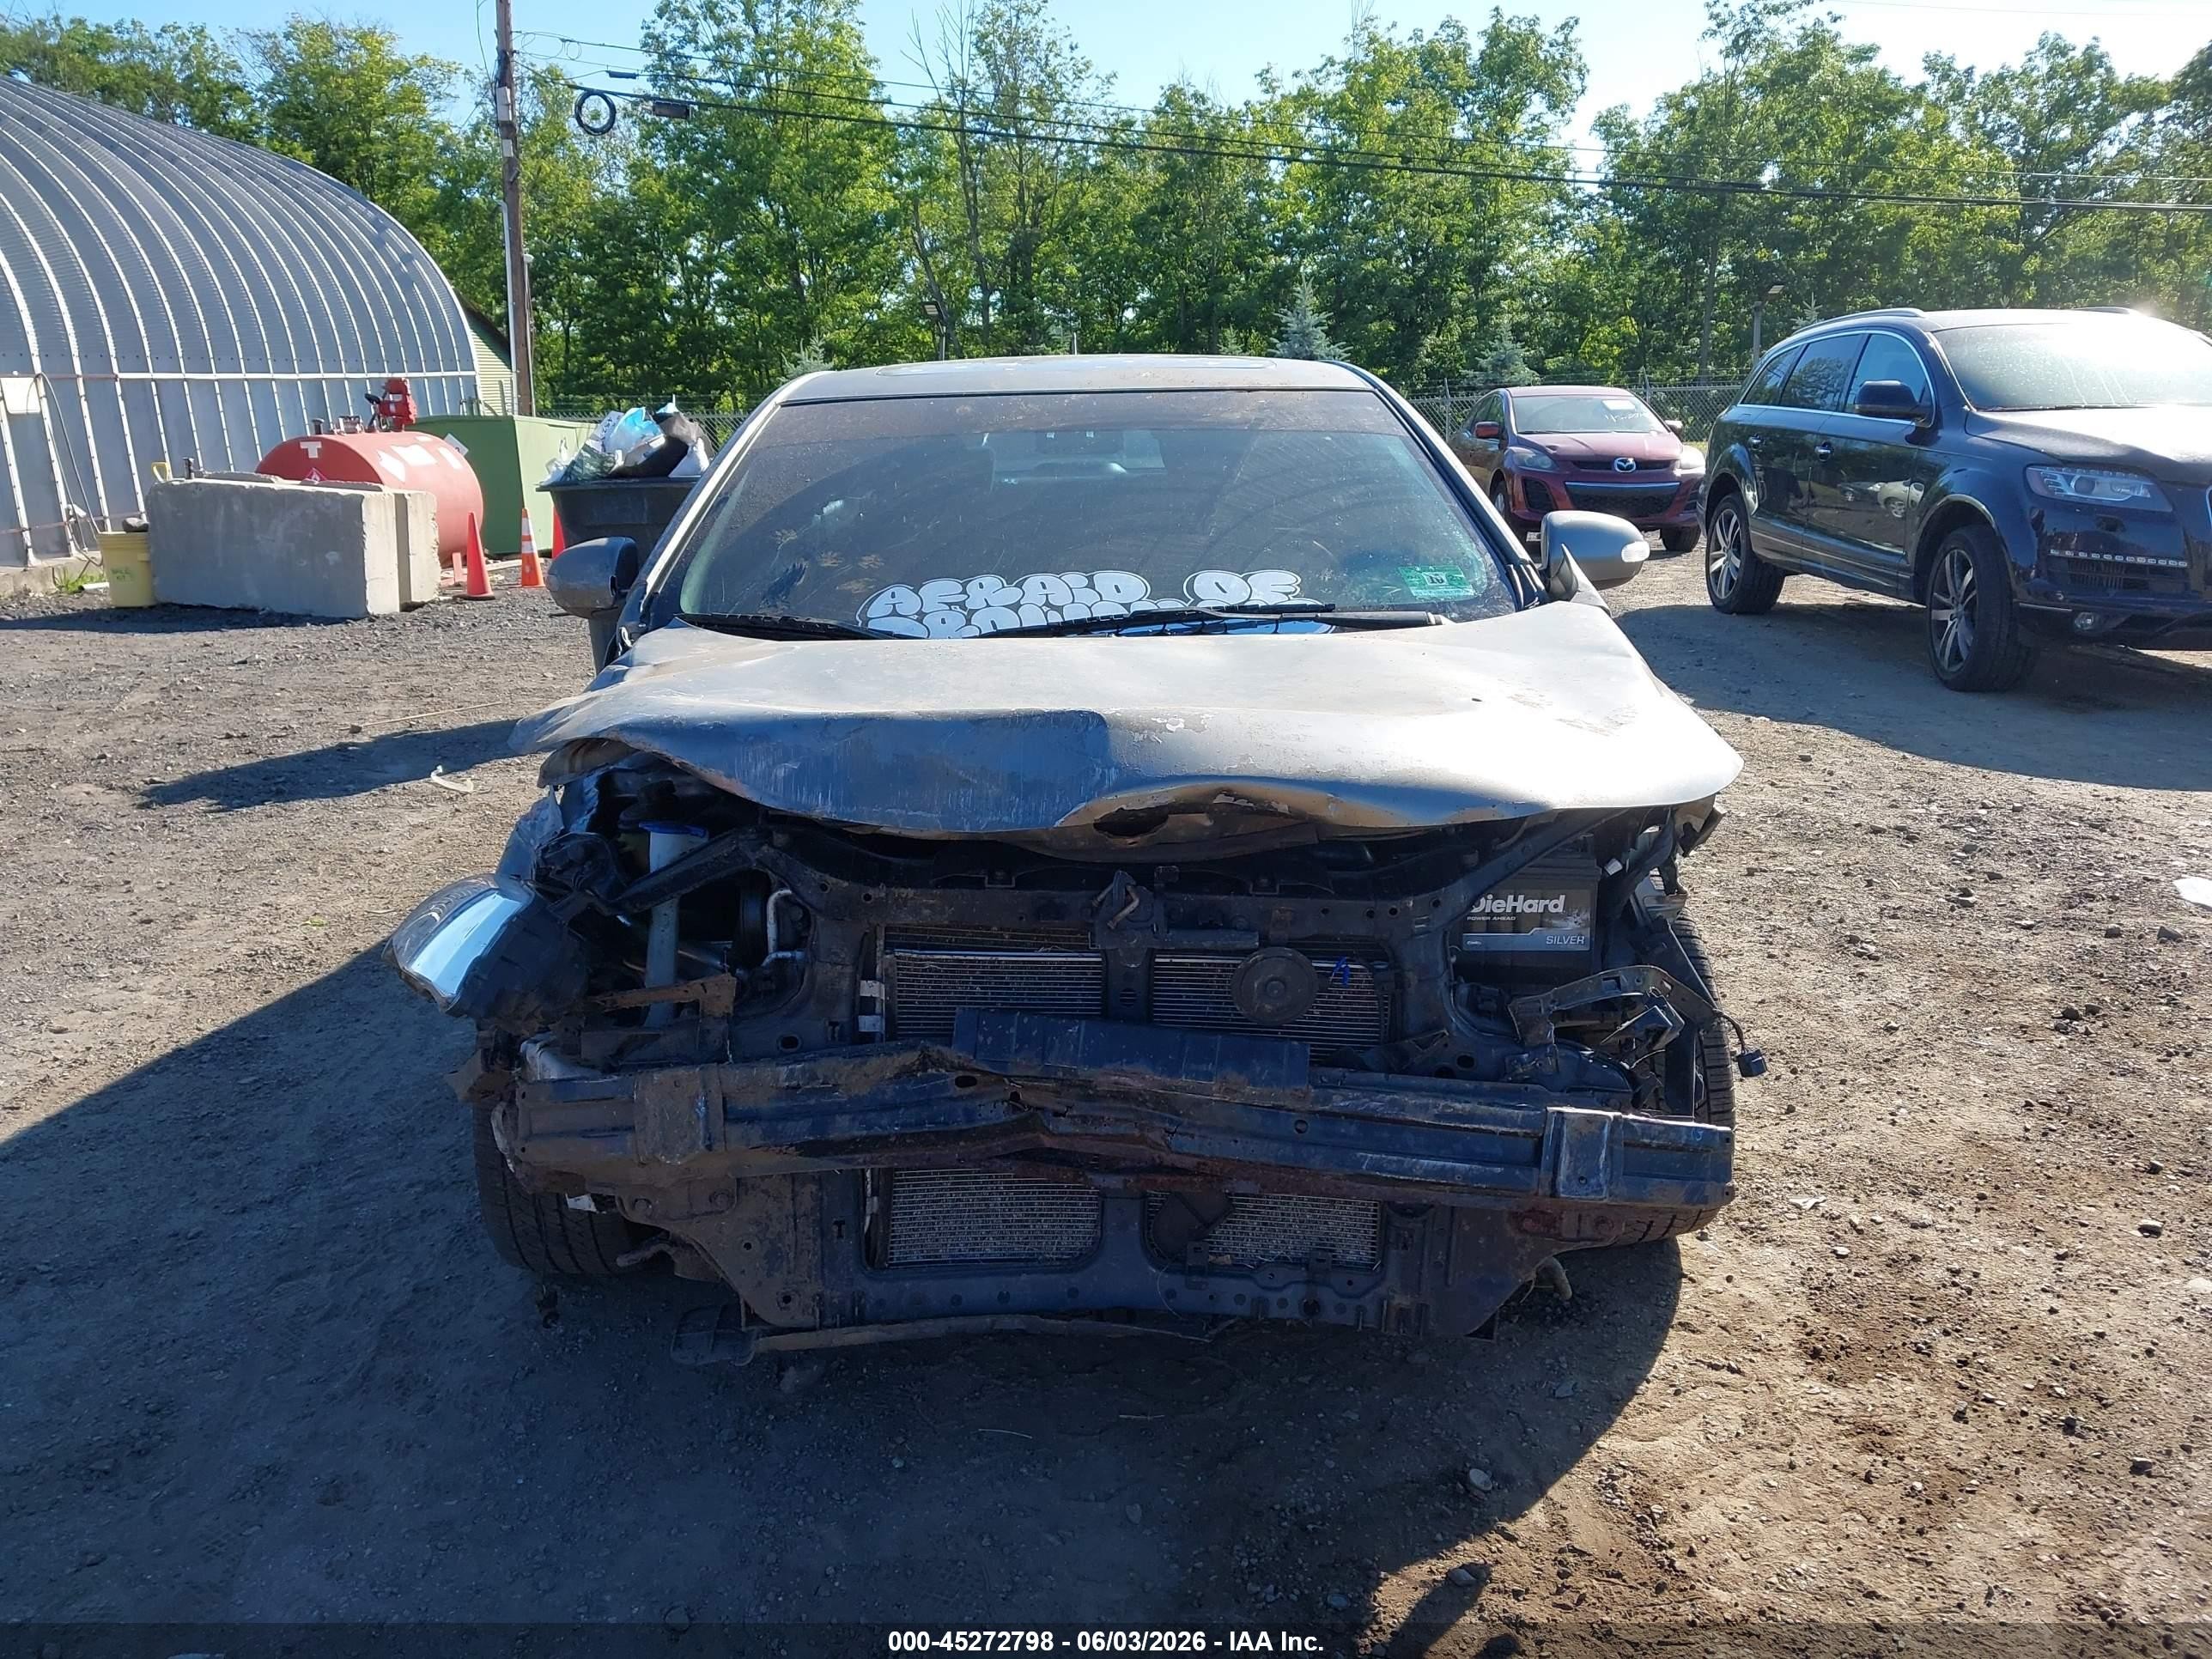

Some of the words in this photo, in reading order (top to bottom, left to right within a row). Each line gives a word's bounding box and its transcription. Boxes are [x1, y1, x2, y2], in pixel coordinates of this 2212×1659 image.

[859, 570, 1151, 622] AFRAID
[1183, 569, 1302, 606] OF
[1547, 935, 1585, 945] SILVER
